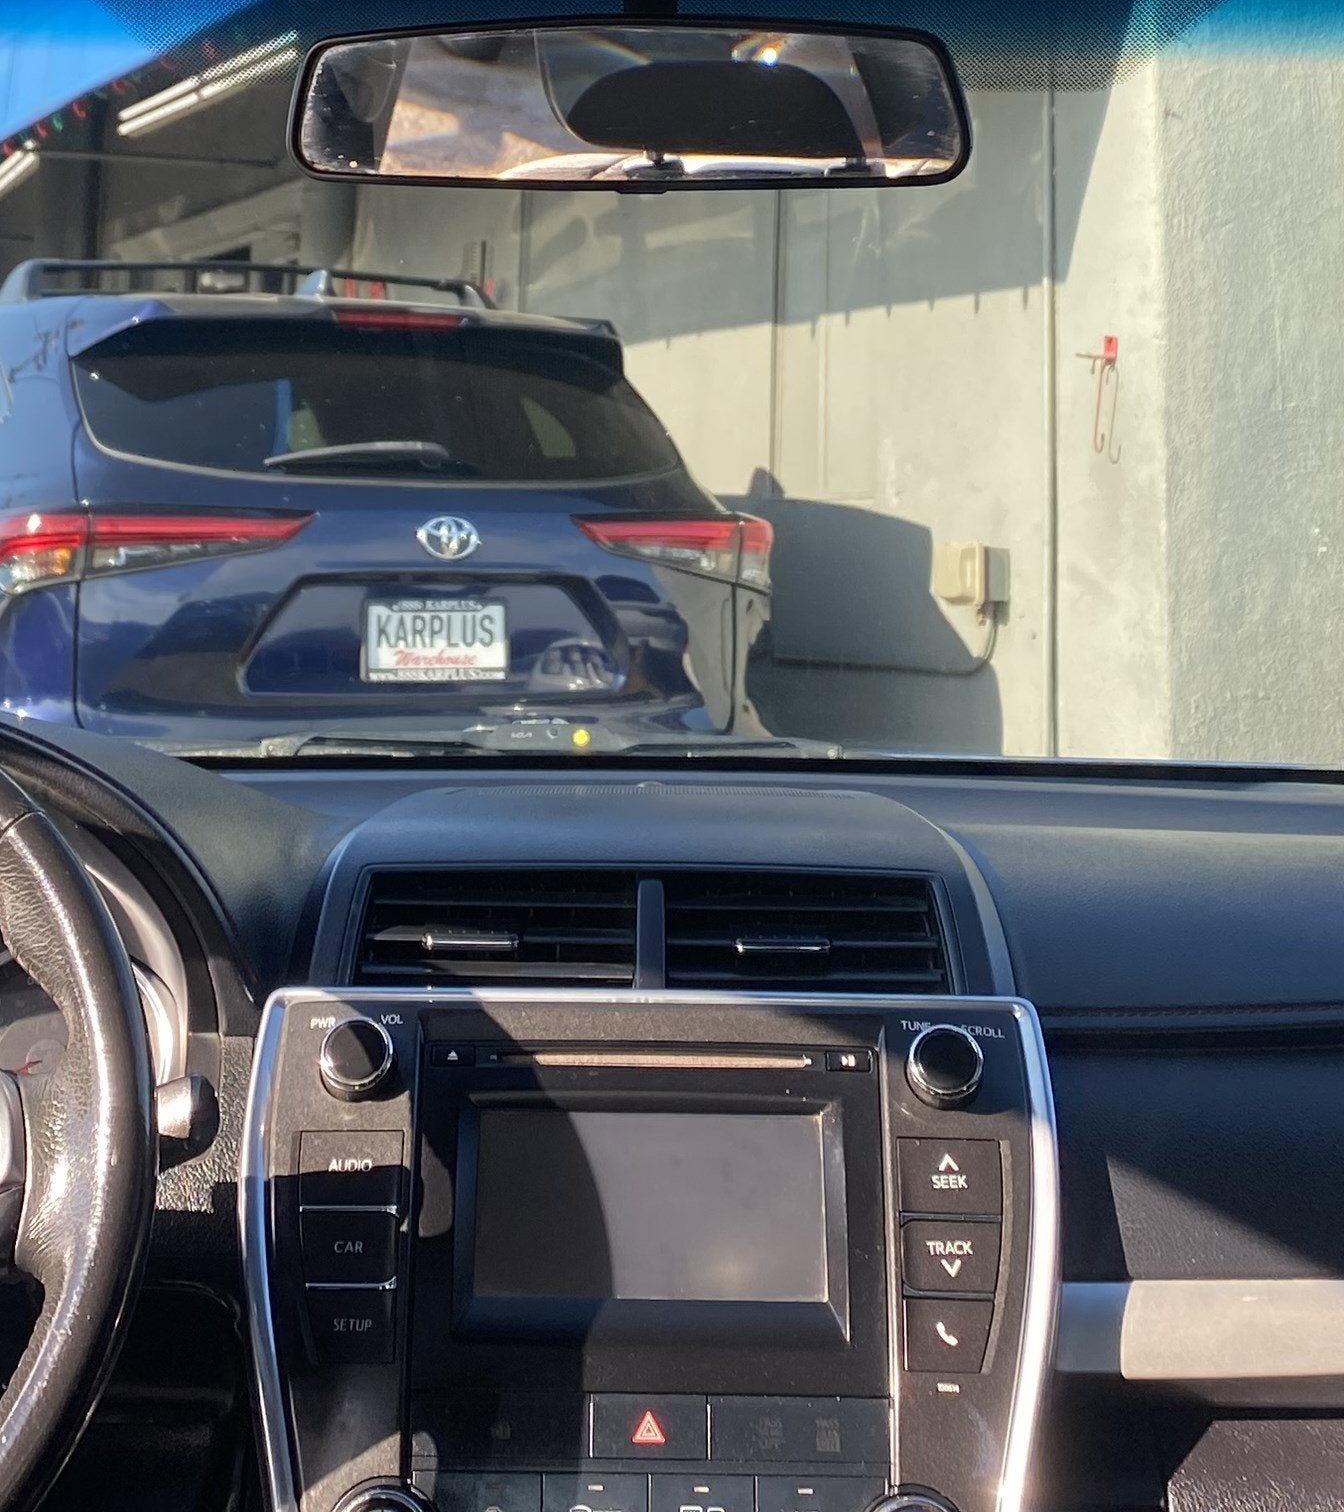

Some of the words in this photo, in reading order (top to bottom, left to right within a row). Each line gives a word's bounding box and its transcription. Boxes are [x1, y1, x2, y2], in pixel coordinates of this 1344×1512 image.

[376, 614, 494, 648] KARPLUS
[393, 649, 478, 667] Warehouse
[310, 1016, 336, 1029] PWR
[379, 1014, 404, 1025] VOL
[900, 1019, 931, 1032] TUNE
[960, 1024, 1005, 1039] SCROLL
[327, 1158, 373, 1173] AUDIO
[931, 1174, 969, 1191] SEEK
[333, 1240, 364, 1255] CAR
[926, 1240, 974, 1257] TRACK
[332, 1317, 373, 1334] SETUP
